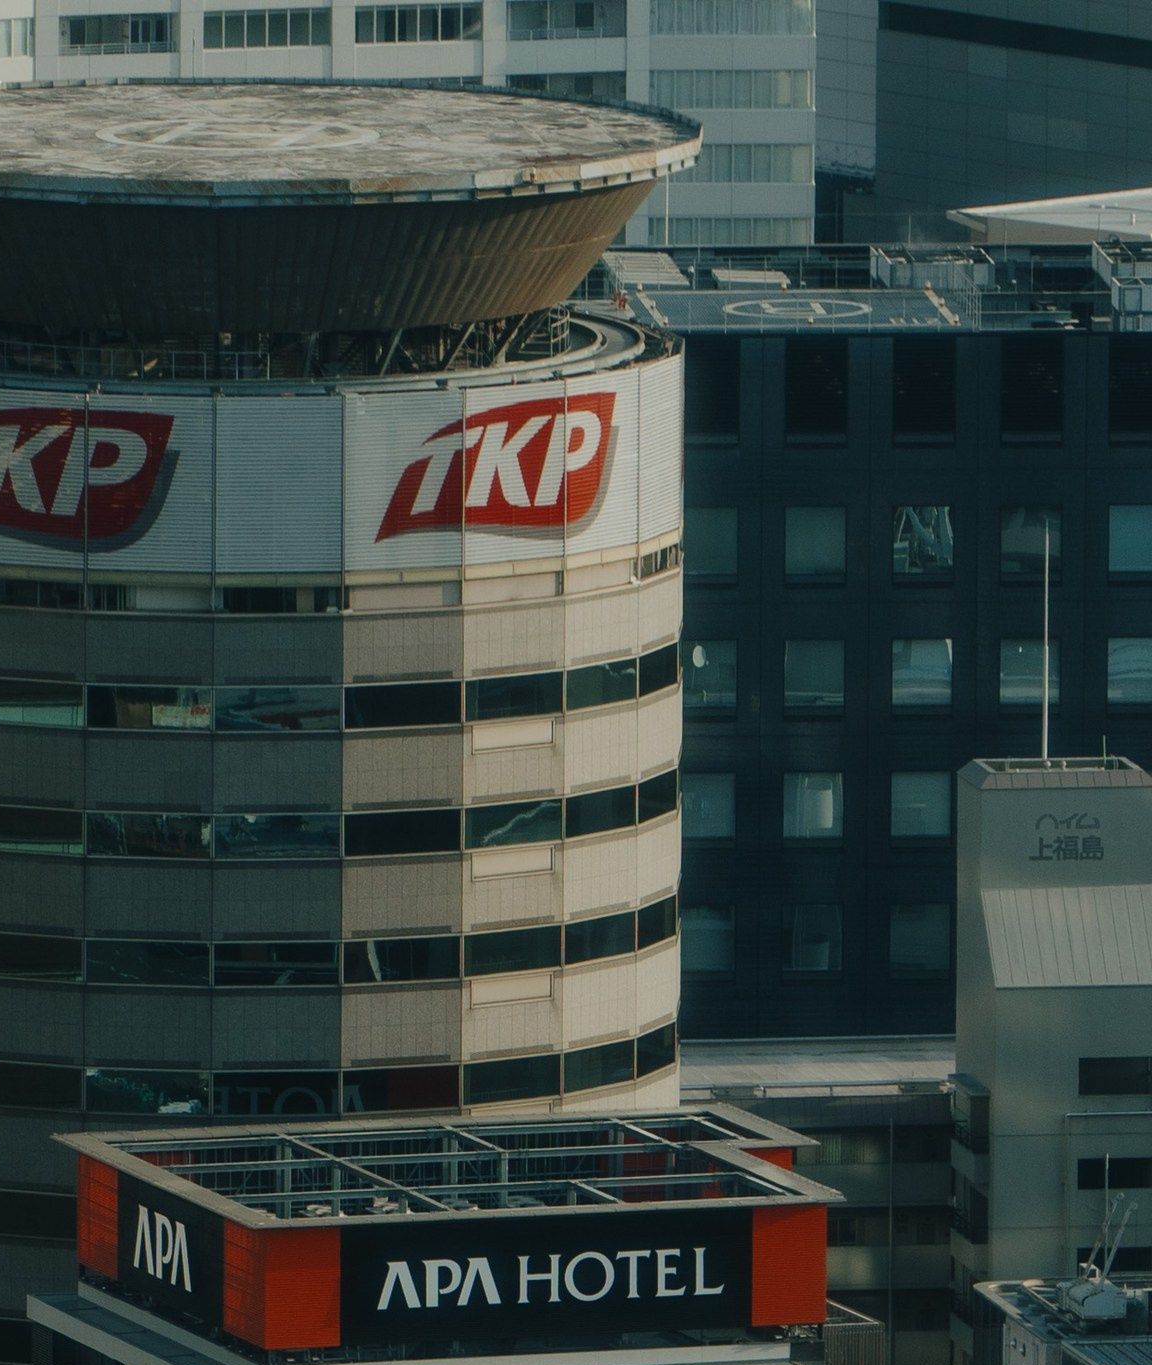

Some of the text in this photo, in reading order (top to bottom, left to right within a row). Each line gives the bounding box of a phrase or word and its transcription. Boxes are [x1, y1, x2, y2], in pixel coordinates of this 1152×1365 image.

[410, 410, 602, 516] TKP
[1029, 835, 1104, 861] 上福島
[1035, 812, 1100, 830] ハイム
[133, 1204, 192, 1293] APA
[377, 1246, 726, 1311] APA HOTEL
